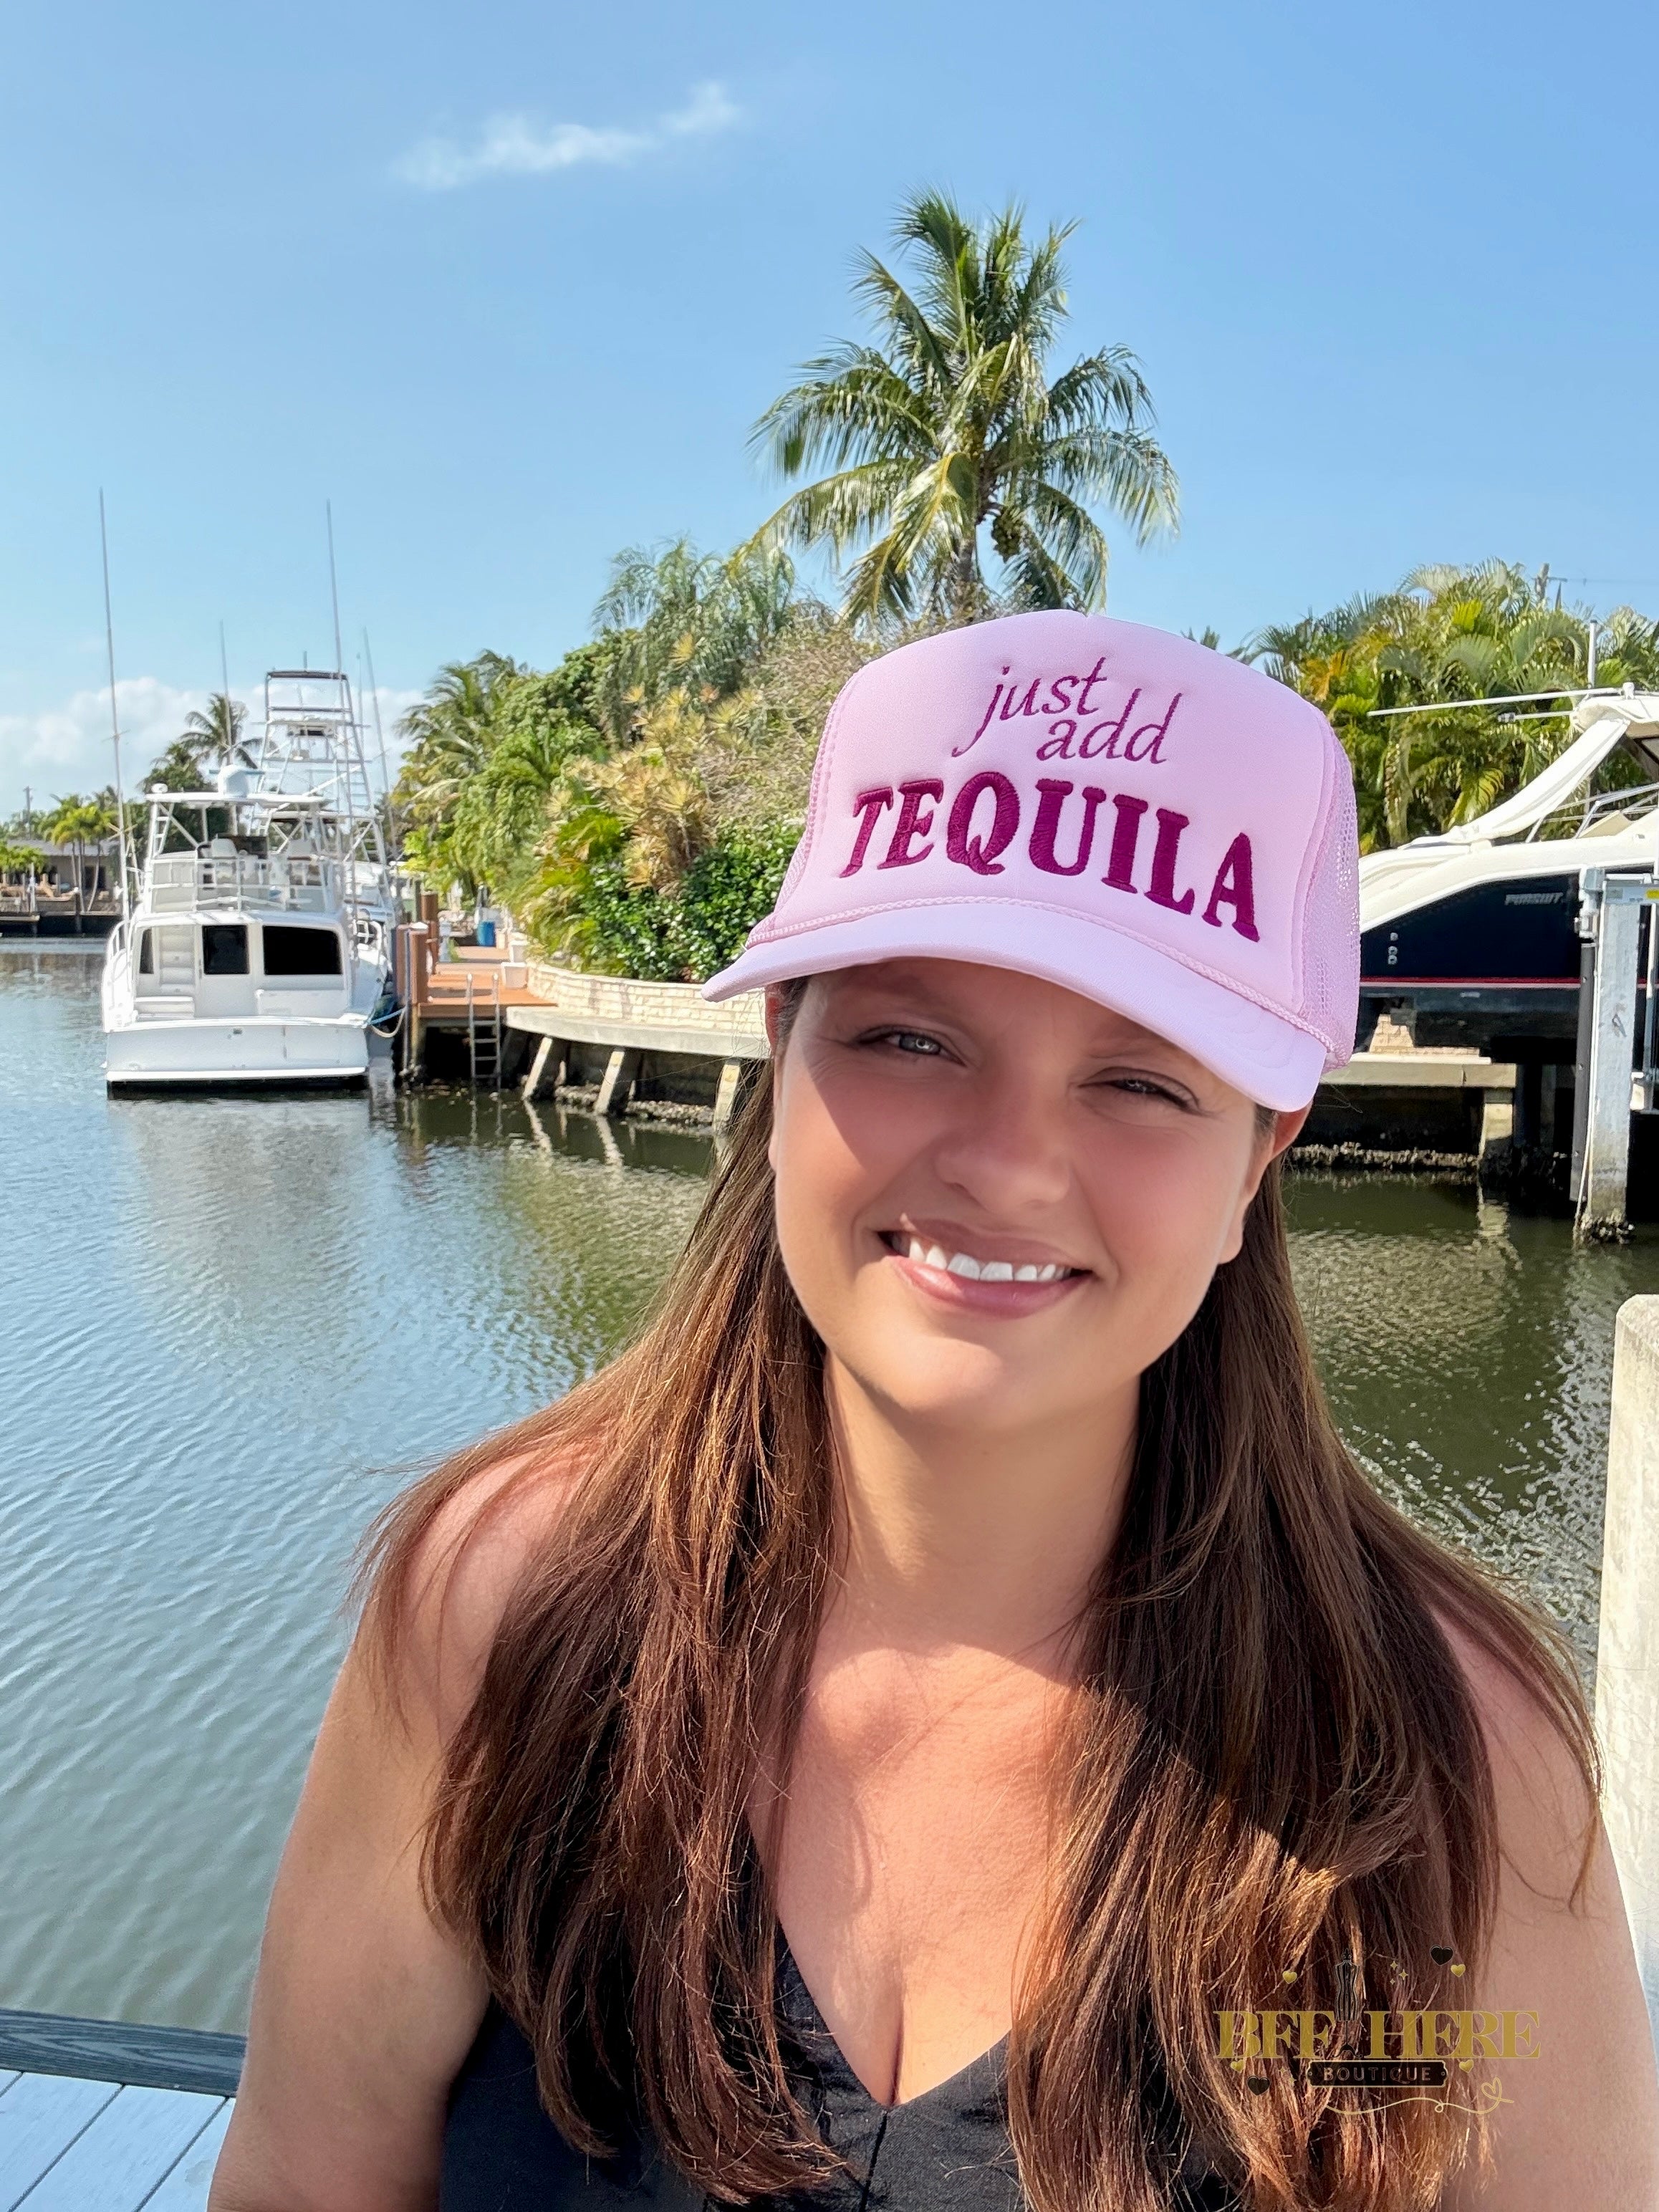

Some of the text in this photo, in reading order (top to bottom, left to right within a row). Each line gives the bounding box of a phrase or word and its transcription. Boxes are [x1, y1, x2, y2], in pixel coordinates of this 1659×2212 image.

[951, 657, 1107, 757] just
[1036, 688, 1183, 764] add
[840, 771, 1261, 943] TEQUILA
